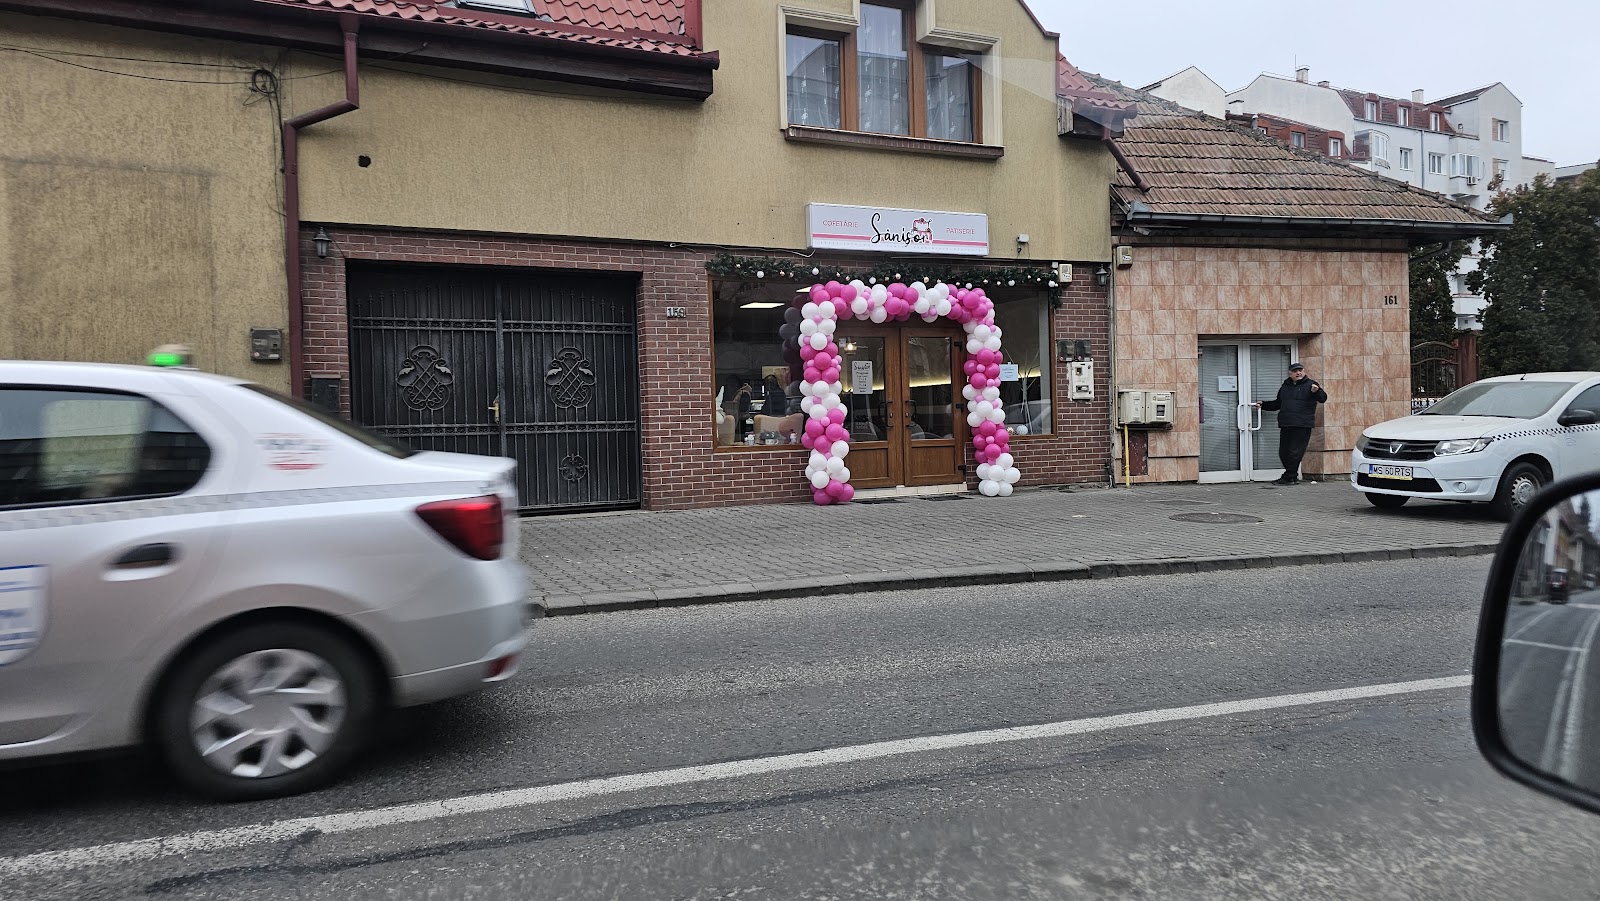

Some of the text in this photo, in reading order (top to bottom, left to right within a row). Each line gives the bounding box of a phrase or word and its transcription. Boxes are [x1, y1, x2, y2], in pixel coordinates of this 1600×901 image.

[1384, 295, 1398, 306] 161
[1373, 466, 1411, 477] MS 60 RTS
